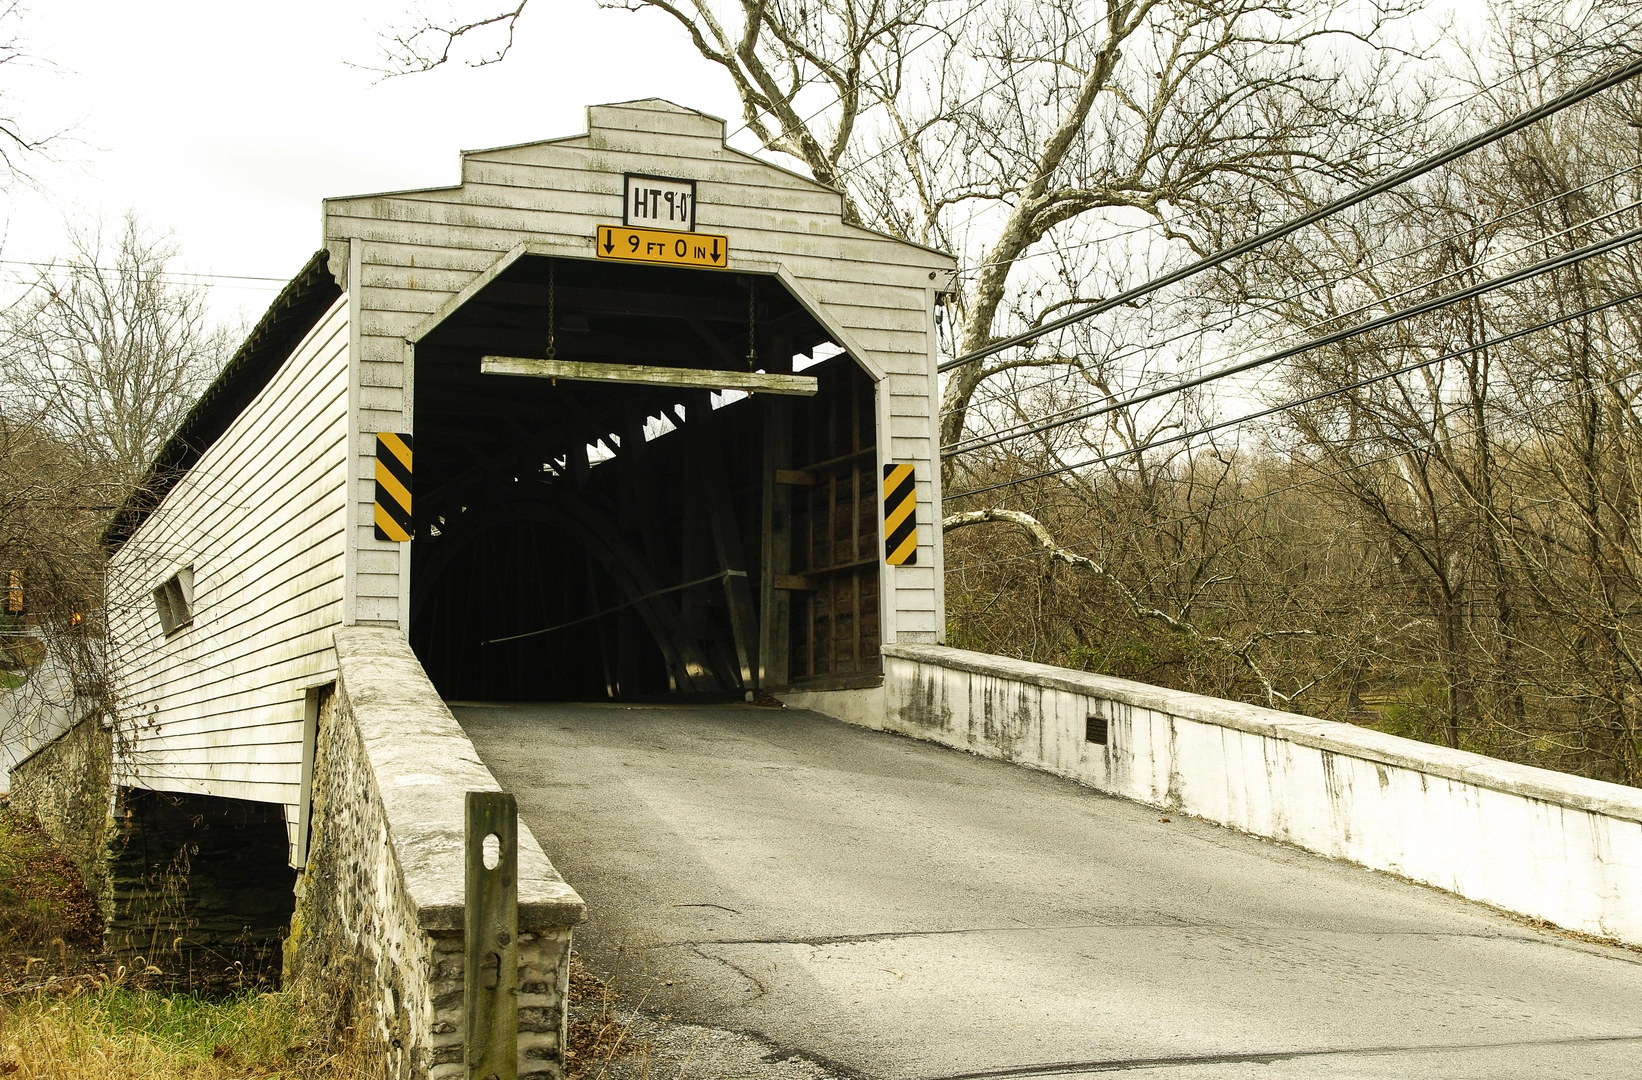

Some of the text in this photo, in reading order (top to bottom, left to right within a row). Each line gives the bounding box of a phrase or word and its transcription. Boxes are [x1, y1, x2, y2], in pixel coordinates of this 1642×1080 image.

[634, 187, 662, 219] HT
[628, 235, 640, 253] 9
[647, 242, 666, 256] FT
[694, 246, 706, 259] IN
